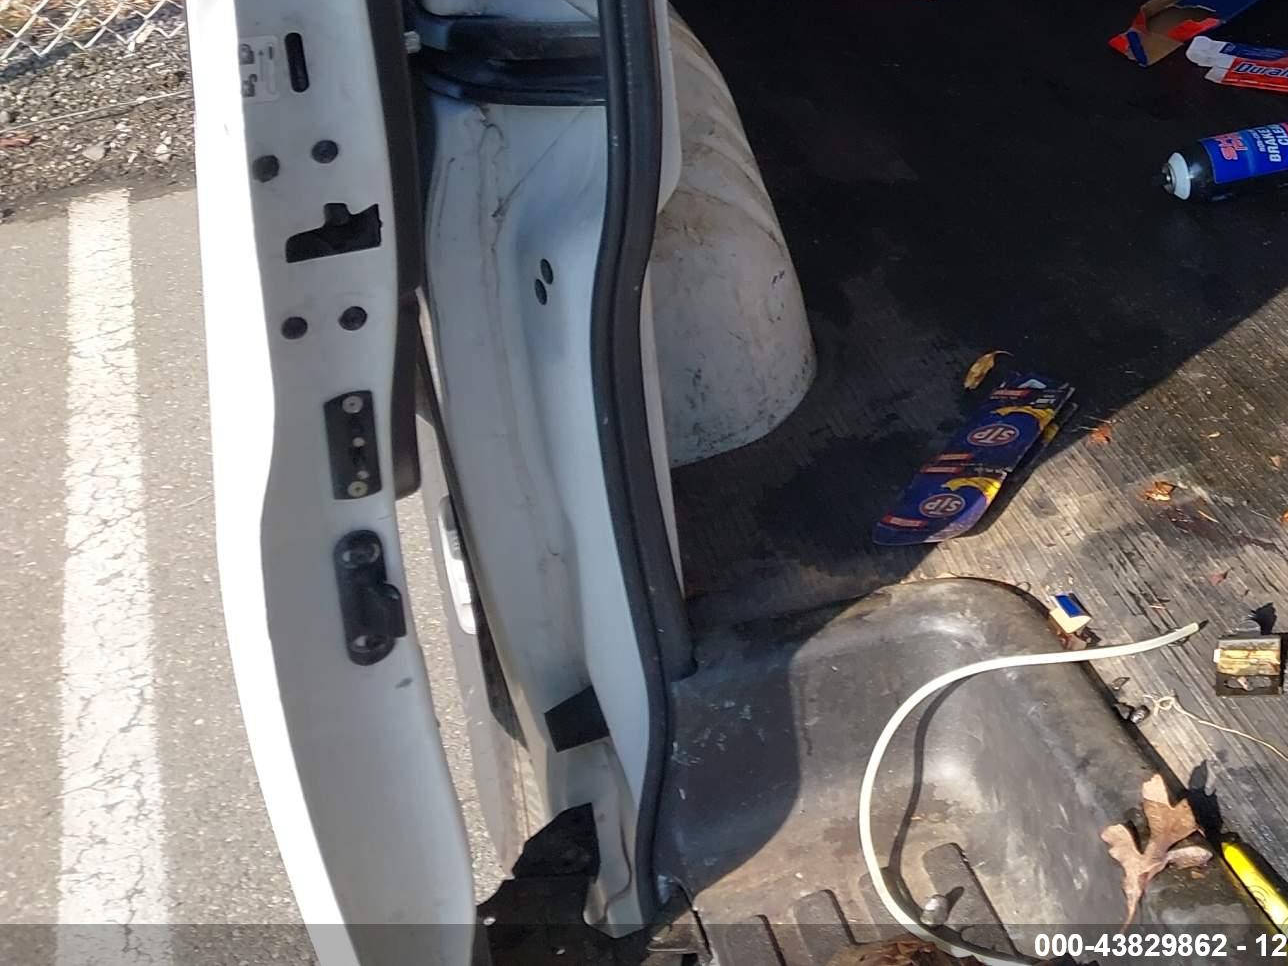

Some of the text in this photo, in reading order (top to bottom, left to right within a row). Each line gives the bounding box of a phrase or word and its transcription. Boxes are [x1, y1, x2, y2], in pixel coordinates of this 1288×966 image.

[1258, 128, 1282, 163] BRAKE
[972, 427, 1018, 444] STP
[926, 498, 962, 516] STP
